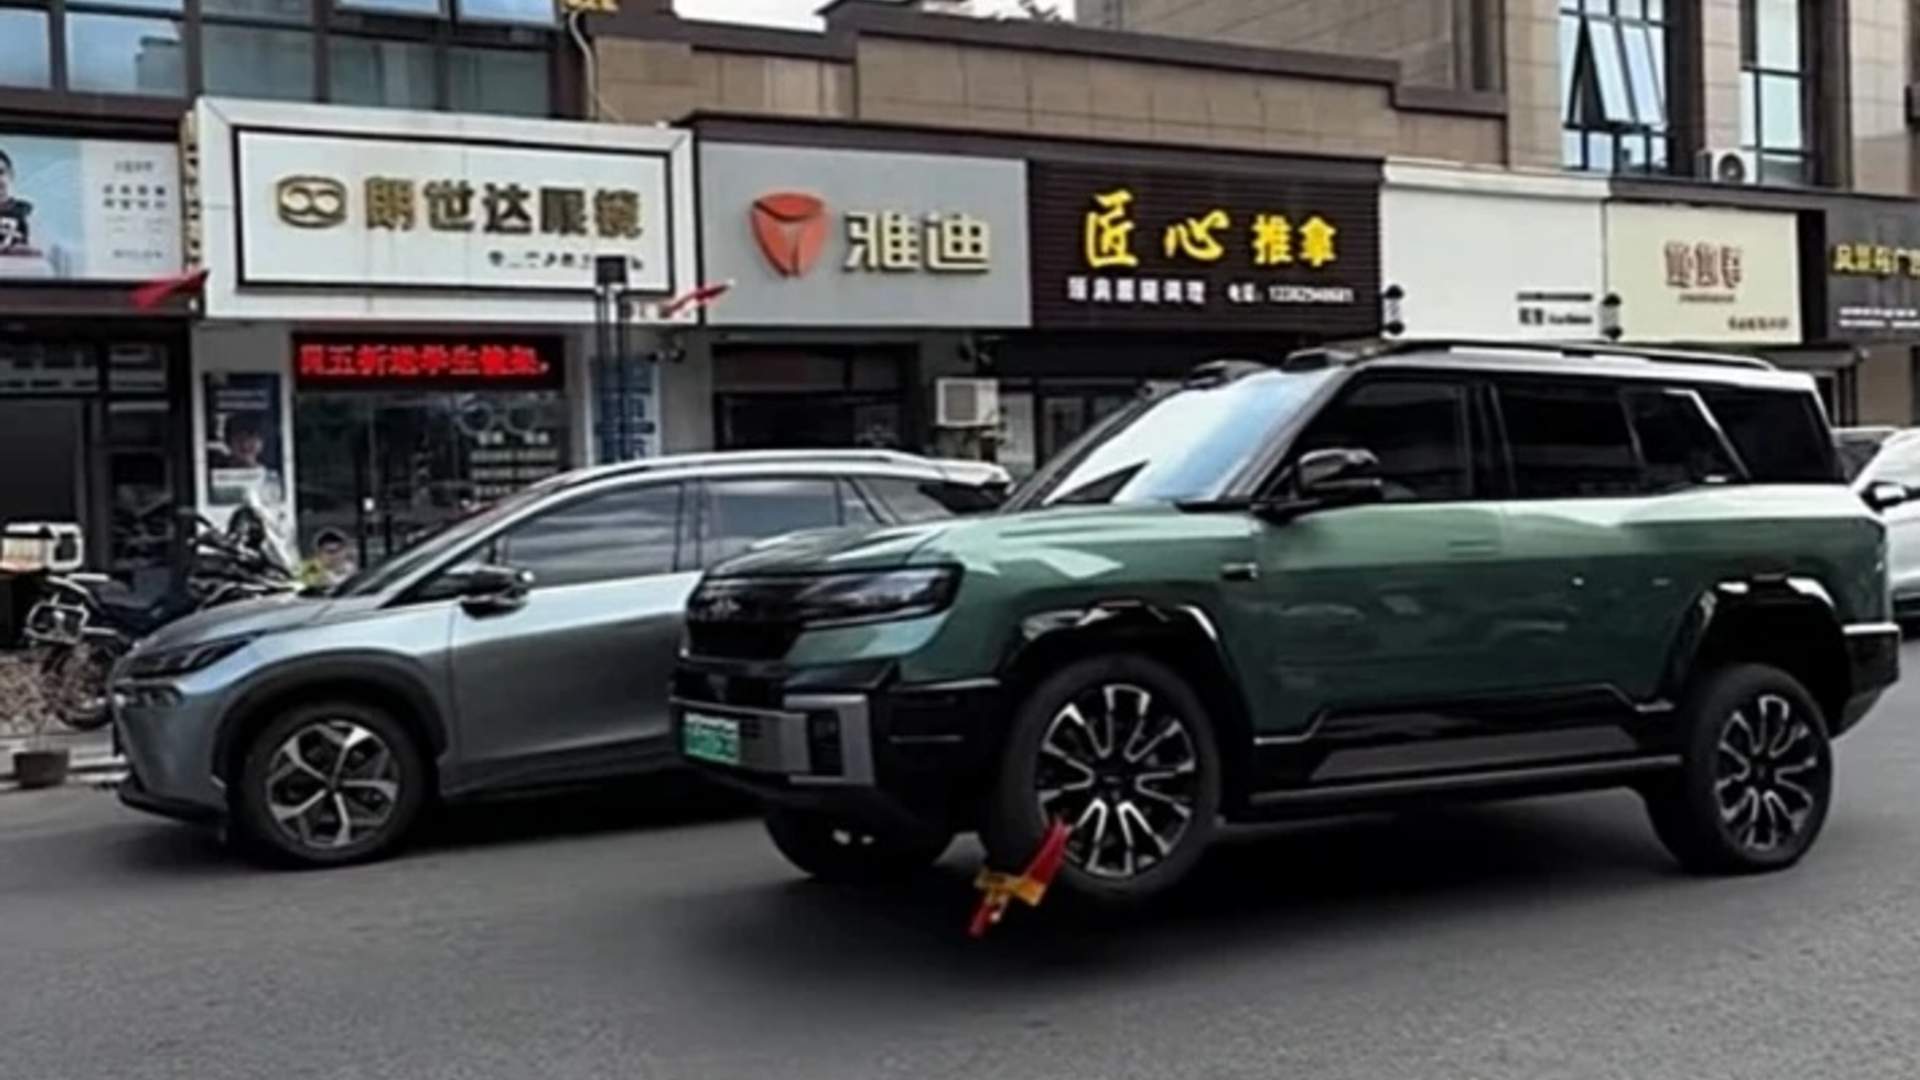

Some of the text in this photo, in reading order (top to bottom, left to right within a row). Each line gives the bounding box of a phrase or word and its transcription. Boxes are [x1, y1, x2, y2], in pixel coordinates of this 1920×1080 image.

[364, 176, 643, 239] 朗世达眼镜
[1086, 189, 1336, 267] 匠心推拿
[843, 210, 991, 273] 雅迪
